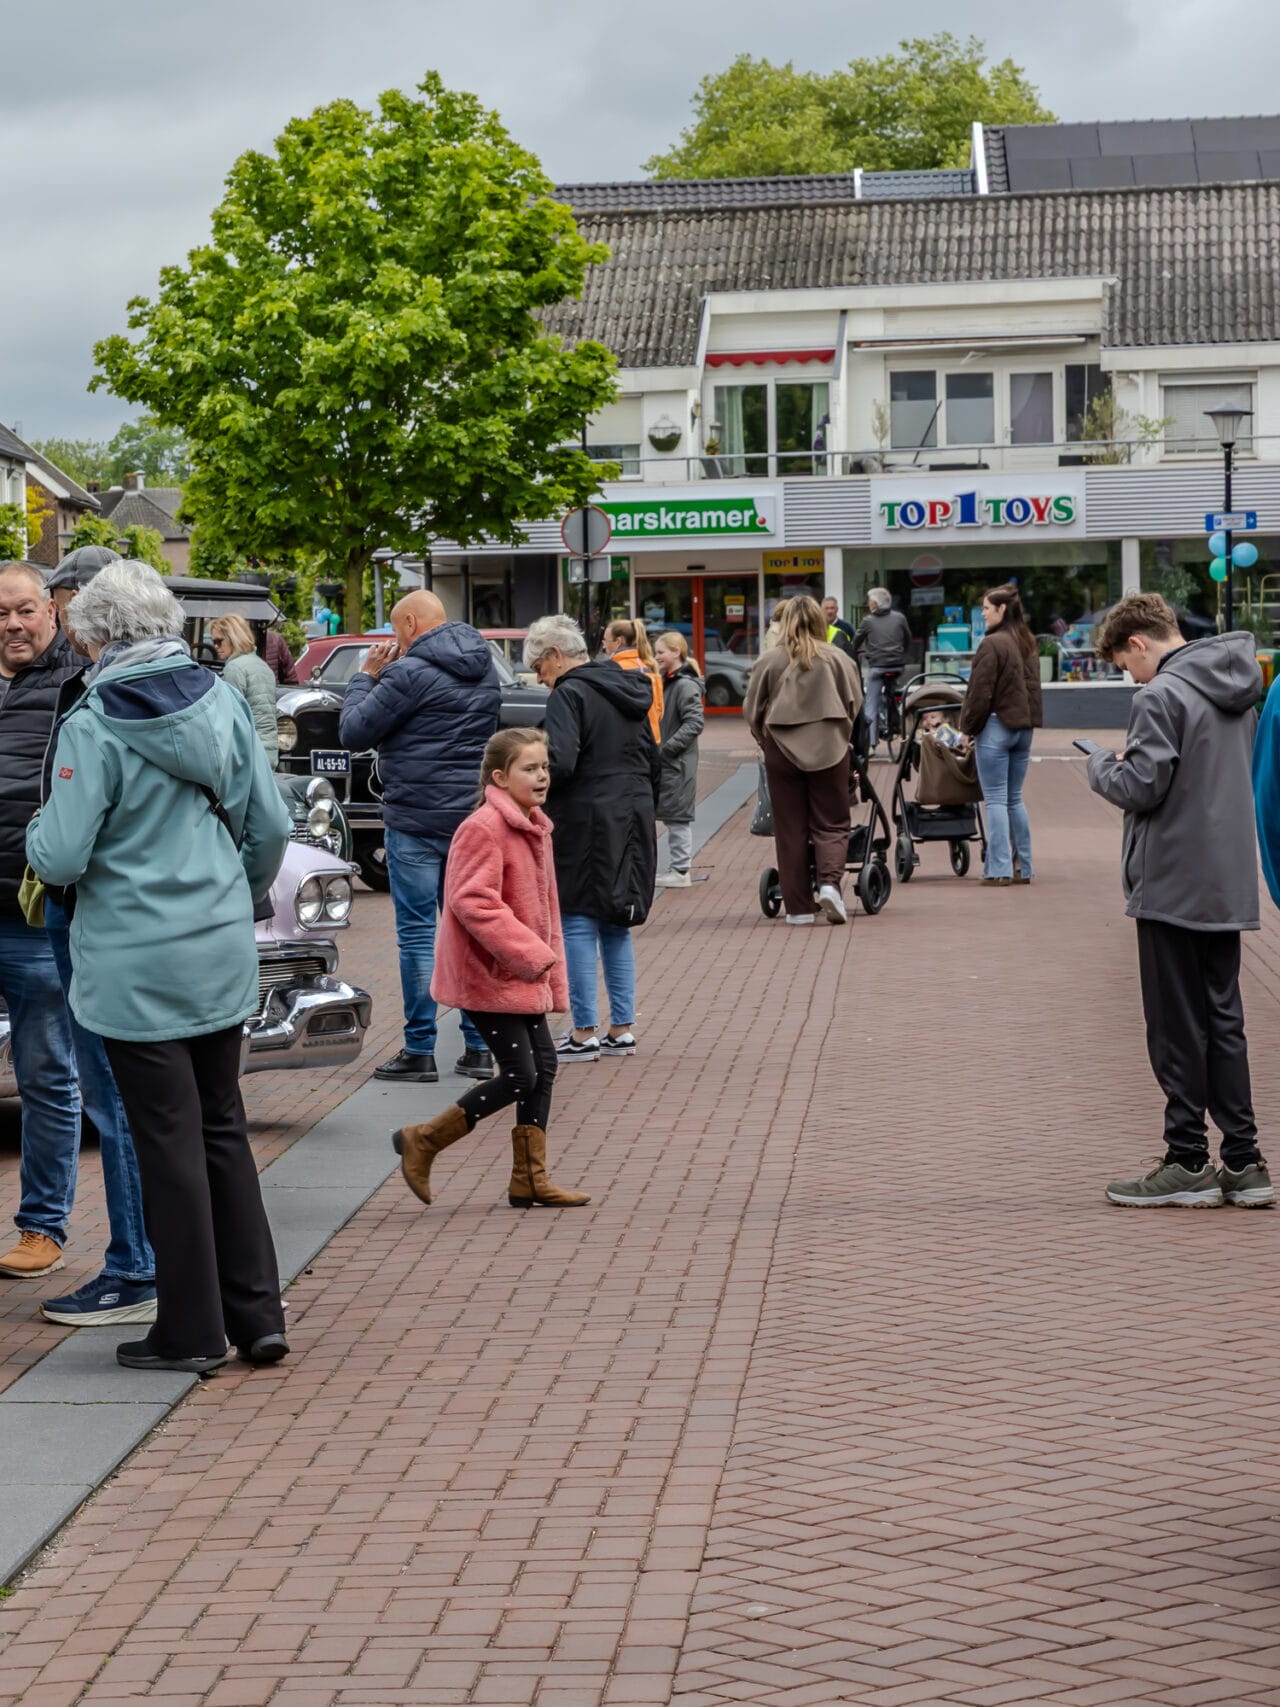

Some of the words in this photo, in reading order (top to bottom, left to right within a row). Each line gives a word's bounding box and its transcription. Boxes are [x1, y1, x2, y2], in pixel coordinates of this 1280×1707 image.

[879, 500, 951, 529] TOP
[954, 491, 982, 526] 1
[985, 495, 1076, 526] TOYS
